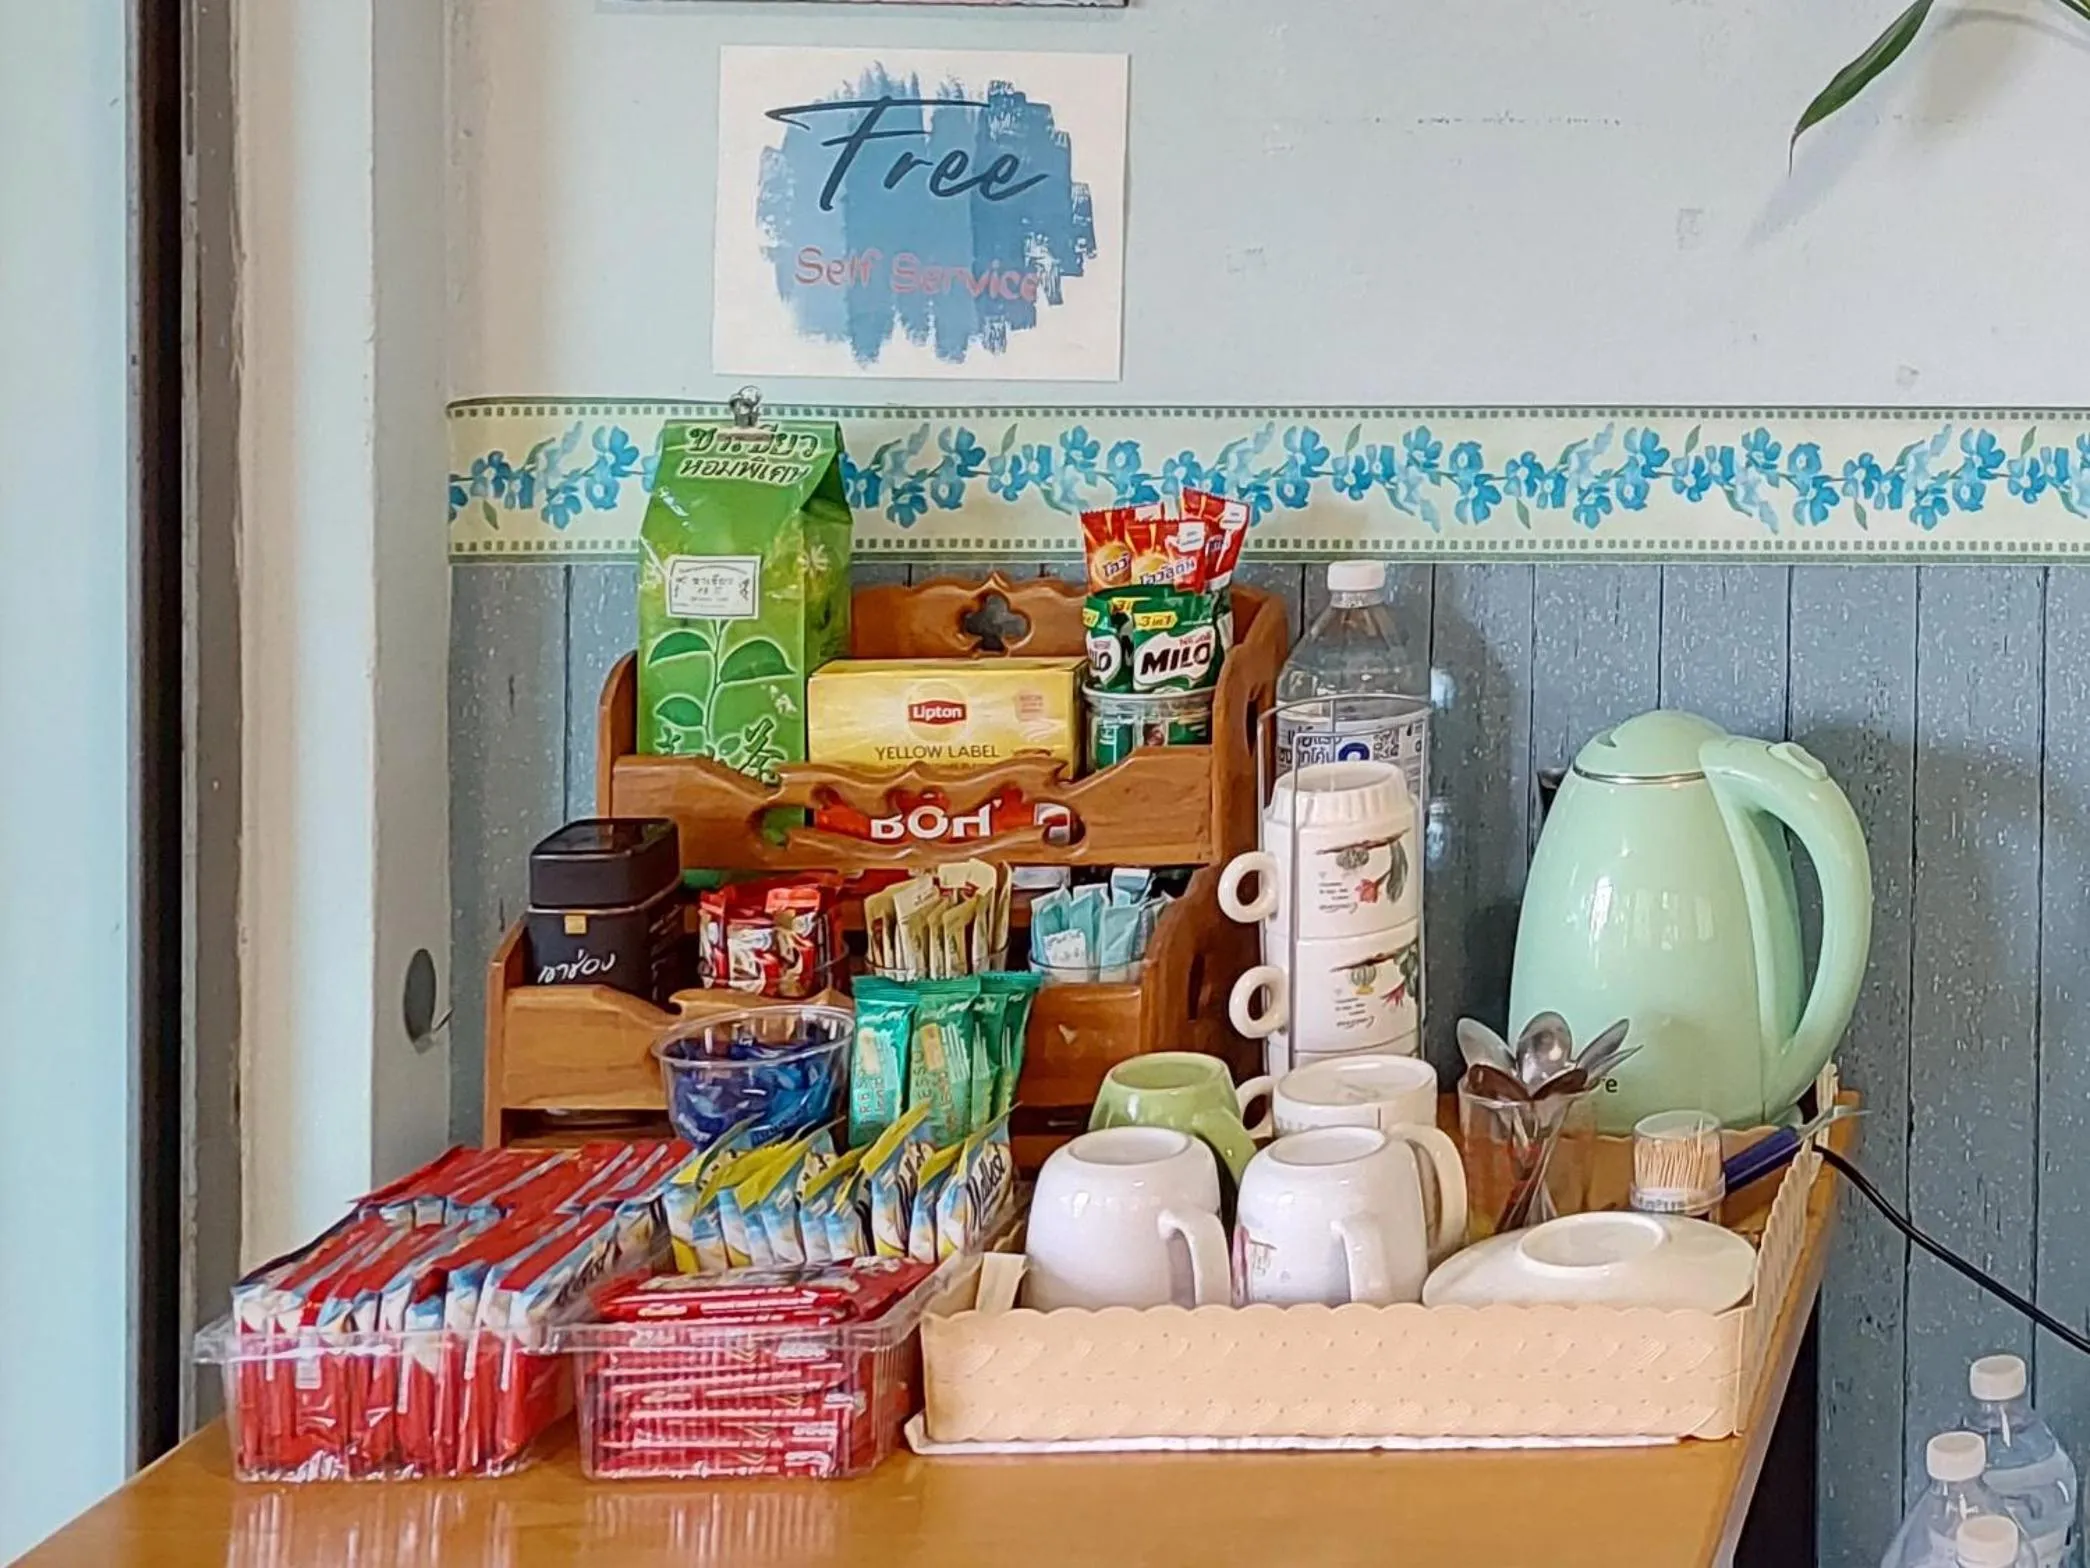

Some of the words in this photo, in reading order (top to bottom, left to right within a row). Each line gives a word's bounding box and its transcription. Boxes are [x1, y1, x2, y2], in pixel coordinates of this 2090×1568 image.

[765, 95, 1050, 212] Free
[795, 246, 884, 288] Self
[890, 253, 1037, 300] Service
[1140, 642, 1212, 676] MILO
[912, 704, 963, 721] Lipton
[874, 744, 943, 761] YELLOW
[947, 744, 1000, 759] LABEL
